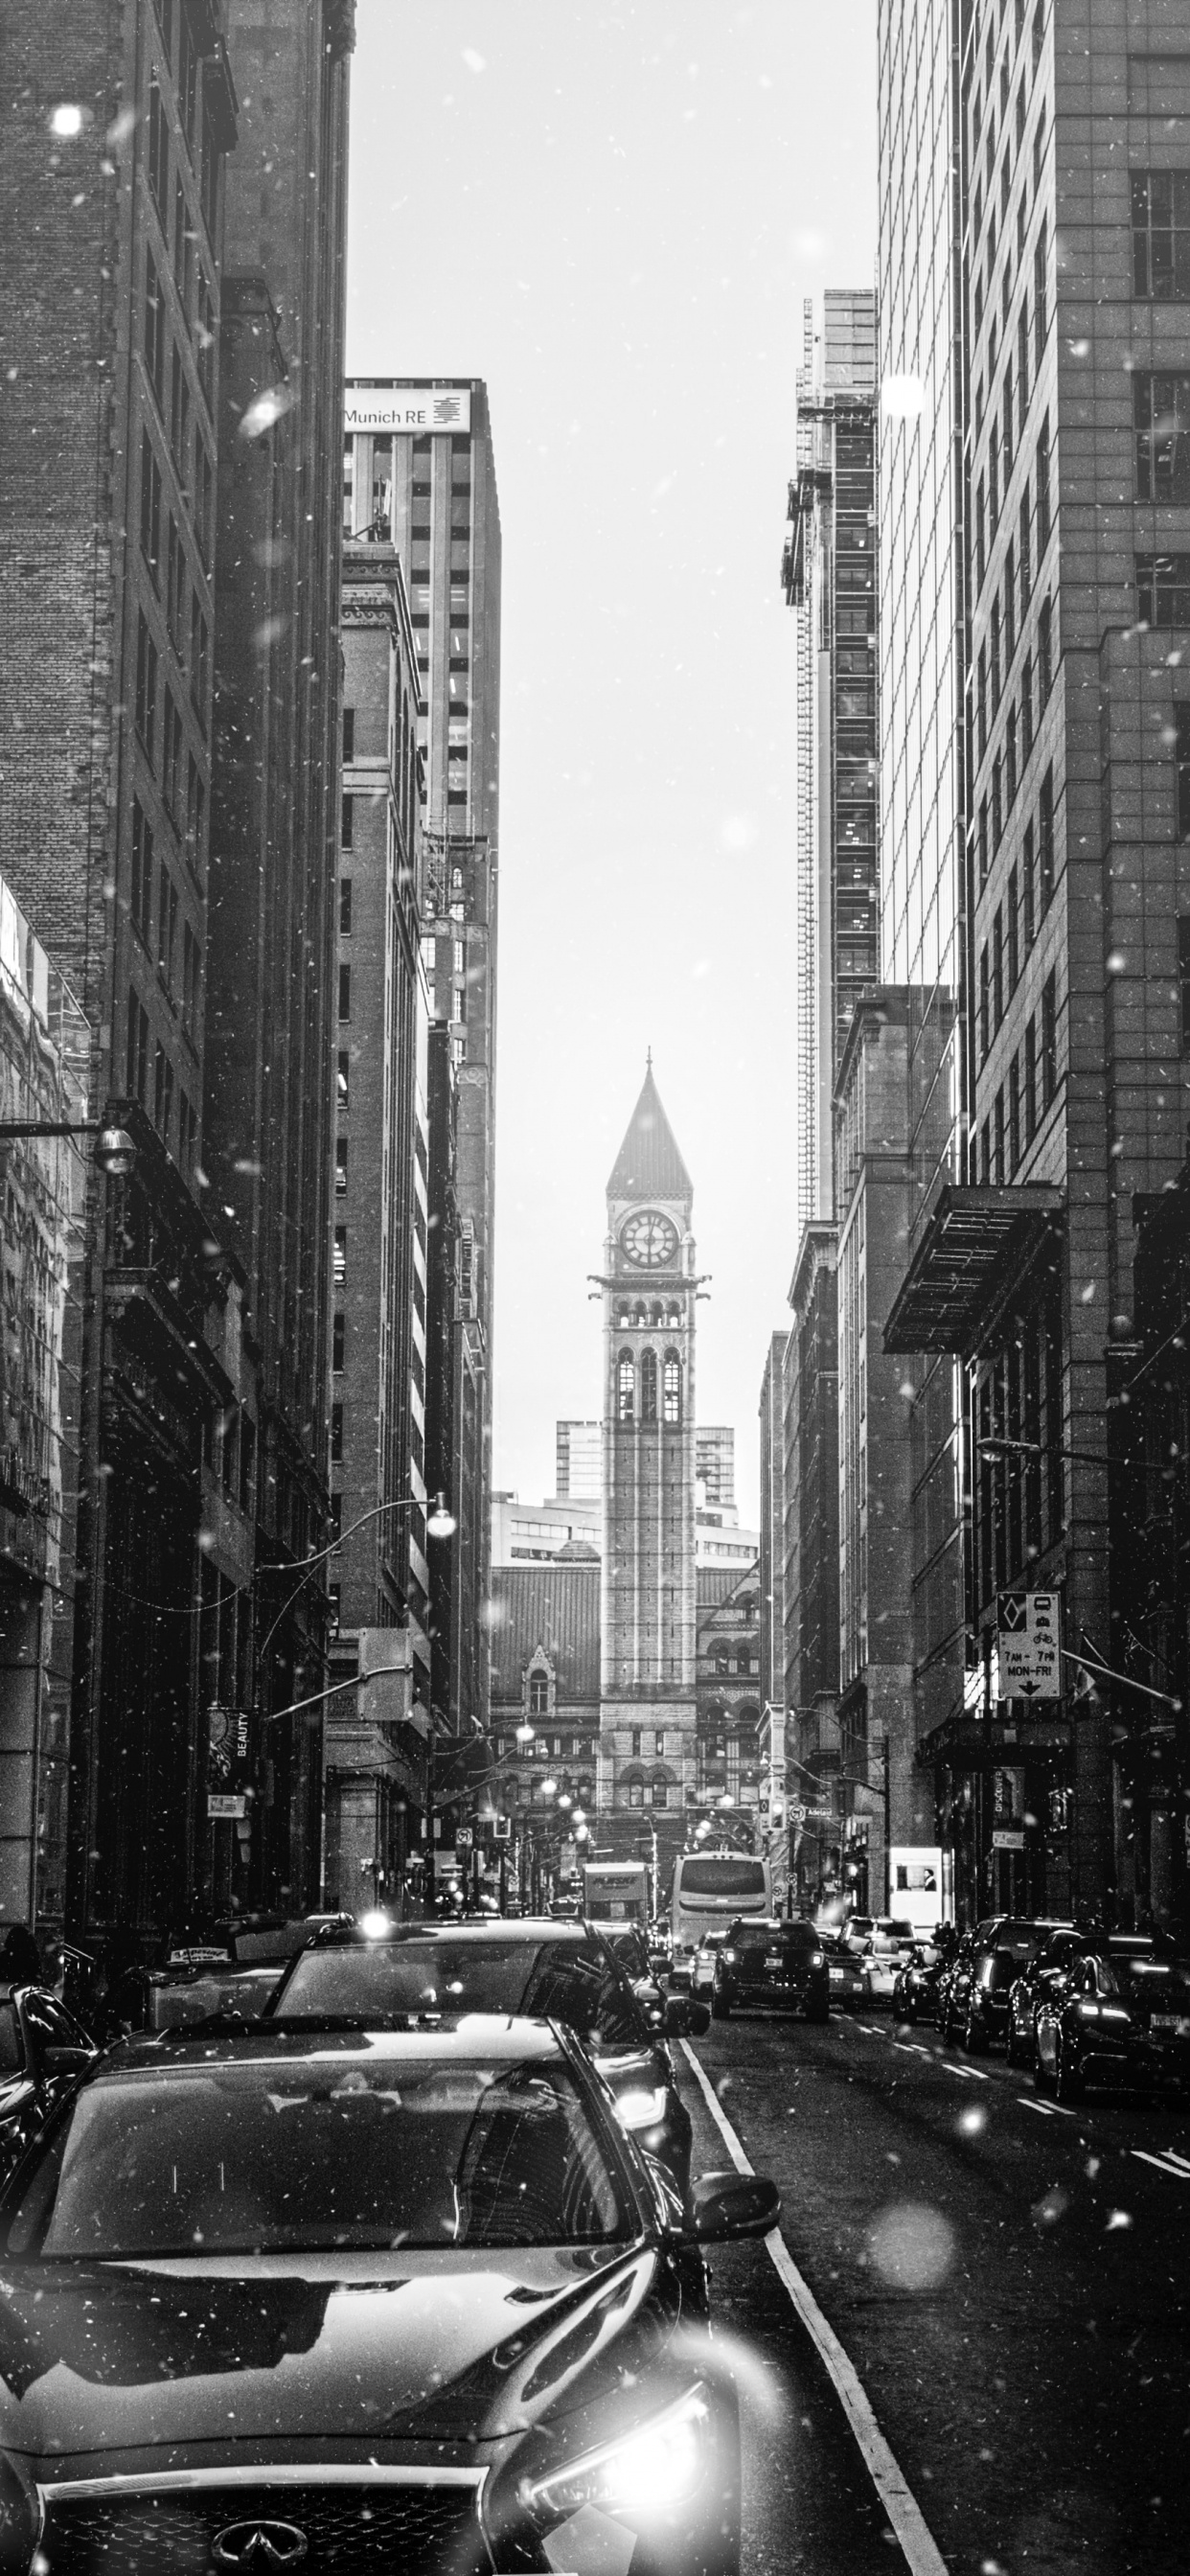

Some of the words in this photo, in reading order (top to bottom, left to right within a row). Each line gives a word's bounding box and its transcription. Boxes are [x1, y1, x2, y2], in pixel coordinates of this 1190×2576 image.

[345, 410, 400, 424] Munich
[405, 410, 426, 424] RE
[1007, 1666, 1052, 1676] MON-FRI
[237, 1713, 248, 1757] BEAUTY
[995, 1770, 1003, 1812] DISCOVER
